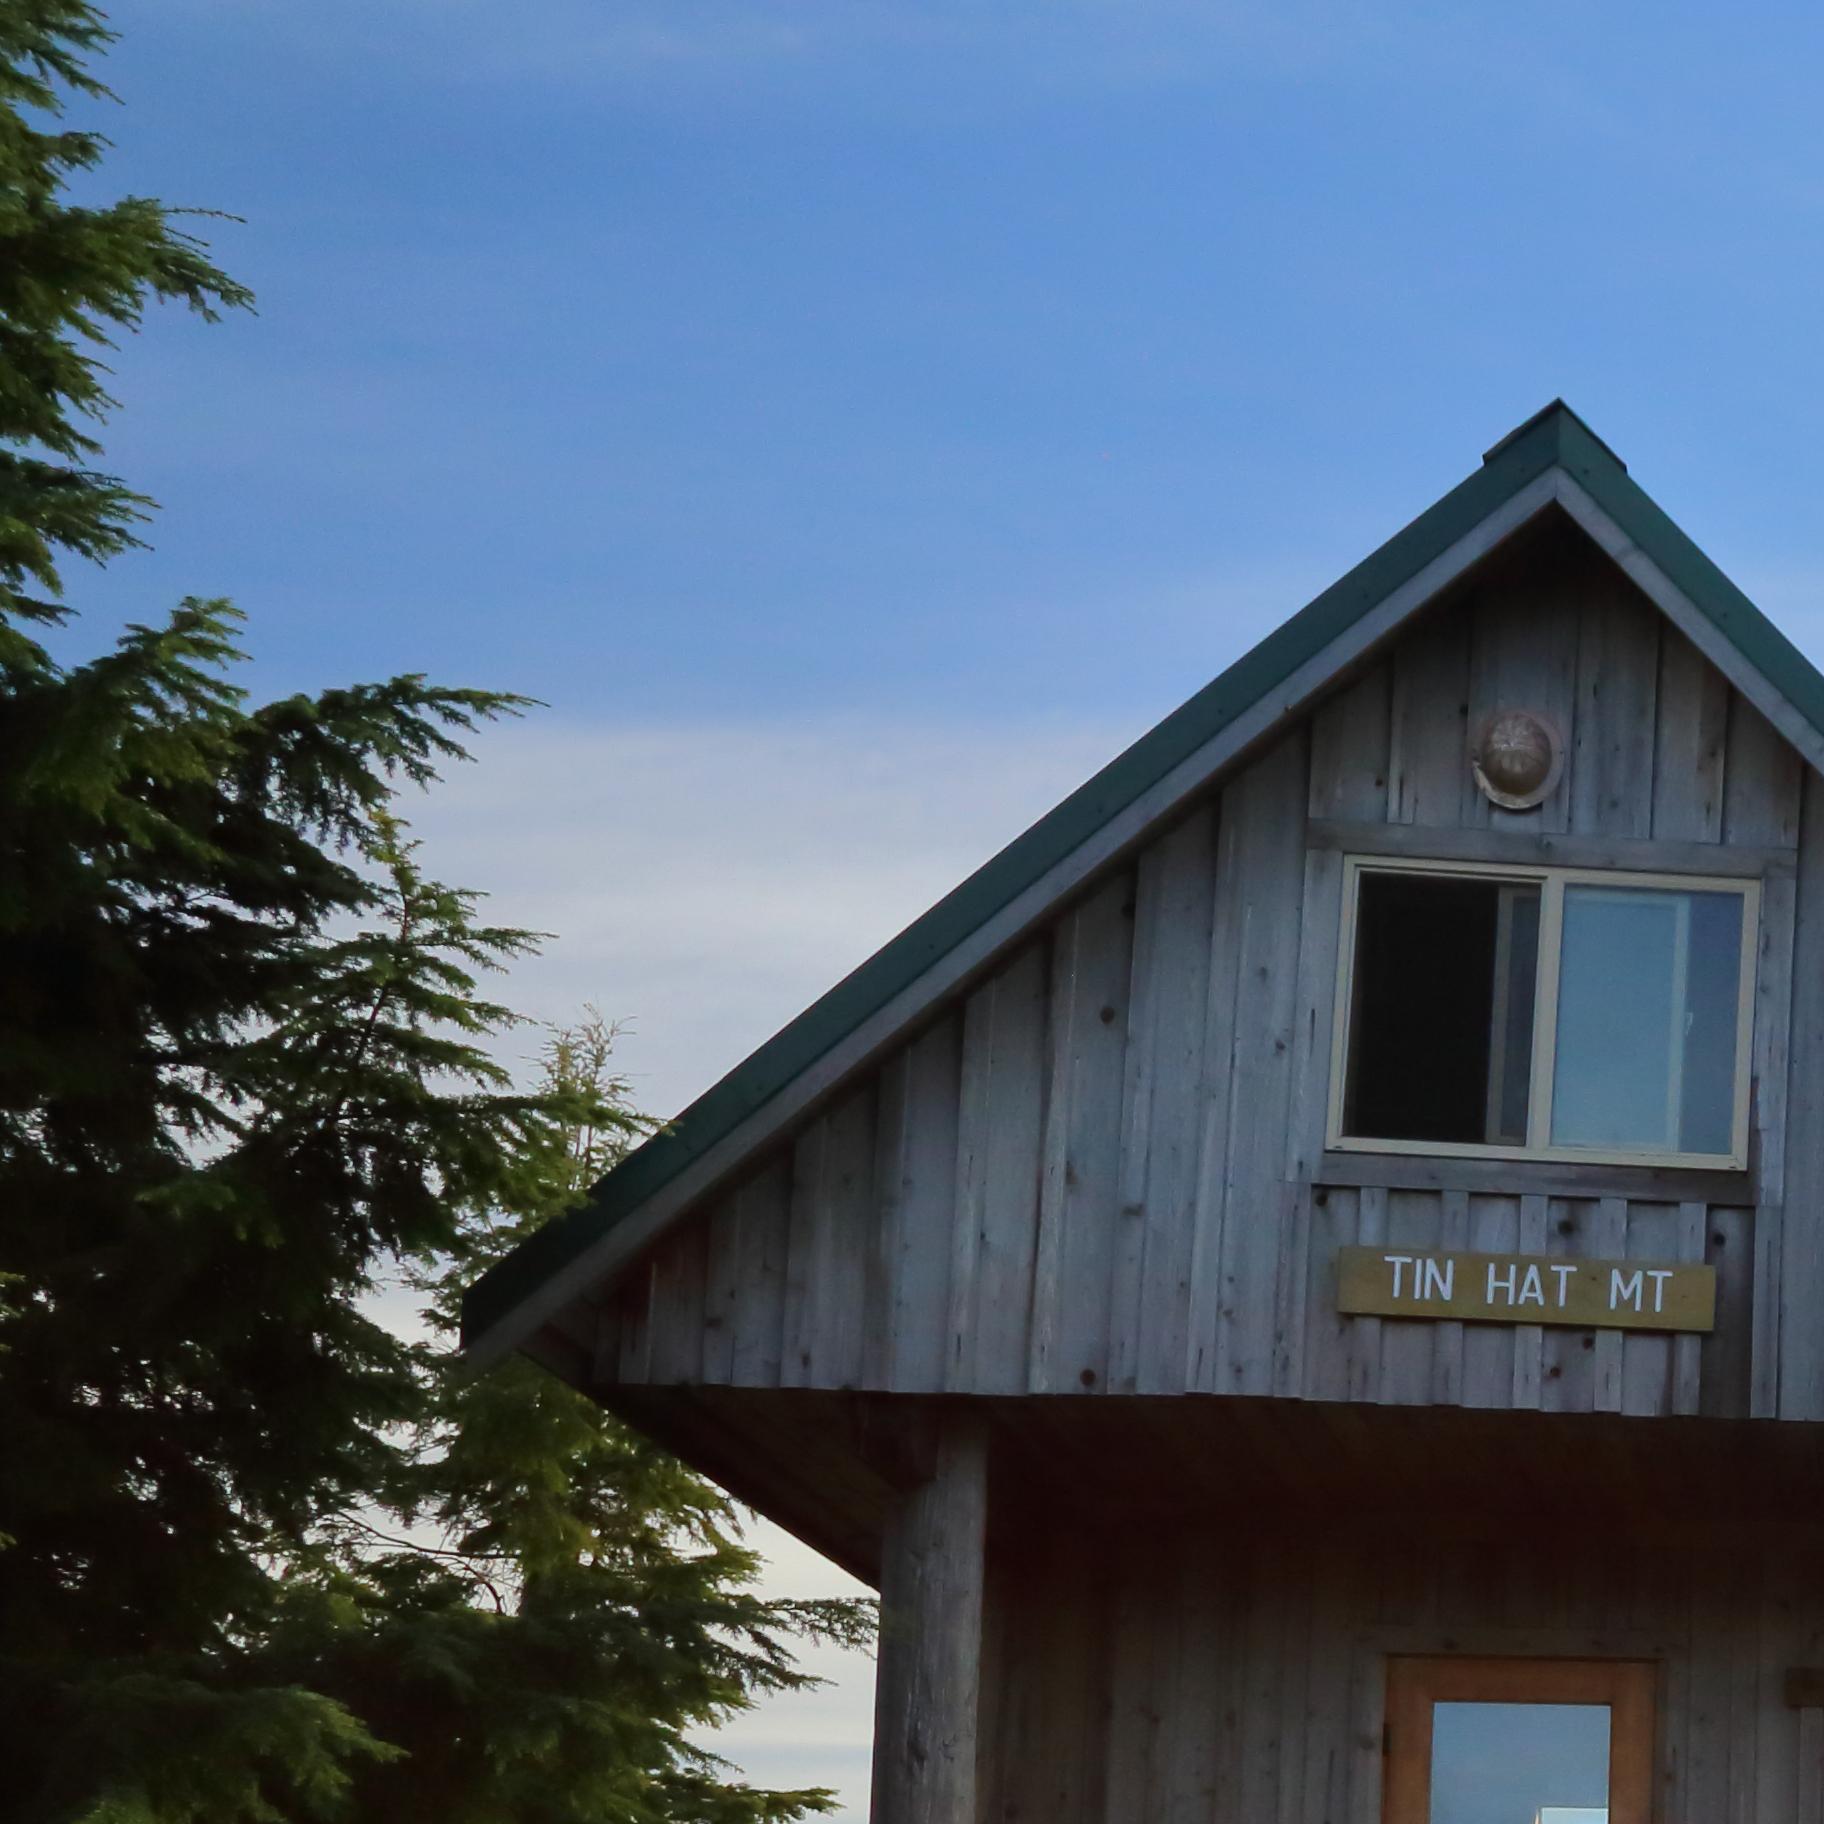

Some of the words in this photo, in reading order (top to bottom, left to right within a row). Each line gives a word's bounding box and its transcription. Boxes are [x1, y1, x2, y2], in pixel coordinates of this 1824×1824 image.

[1384, 1255, 1455, 1301] TIN
[1486, 1262, 1578, 1307] HAT
[1609, 1268, 1673, 1313] MT
